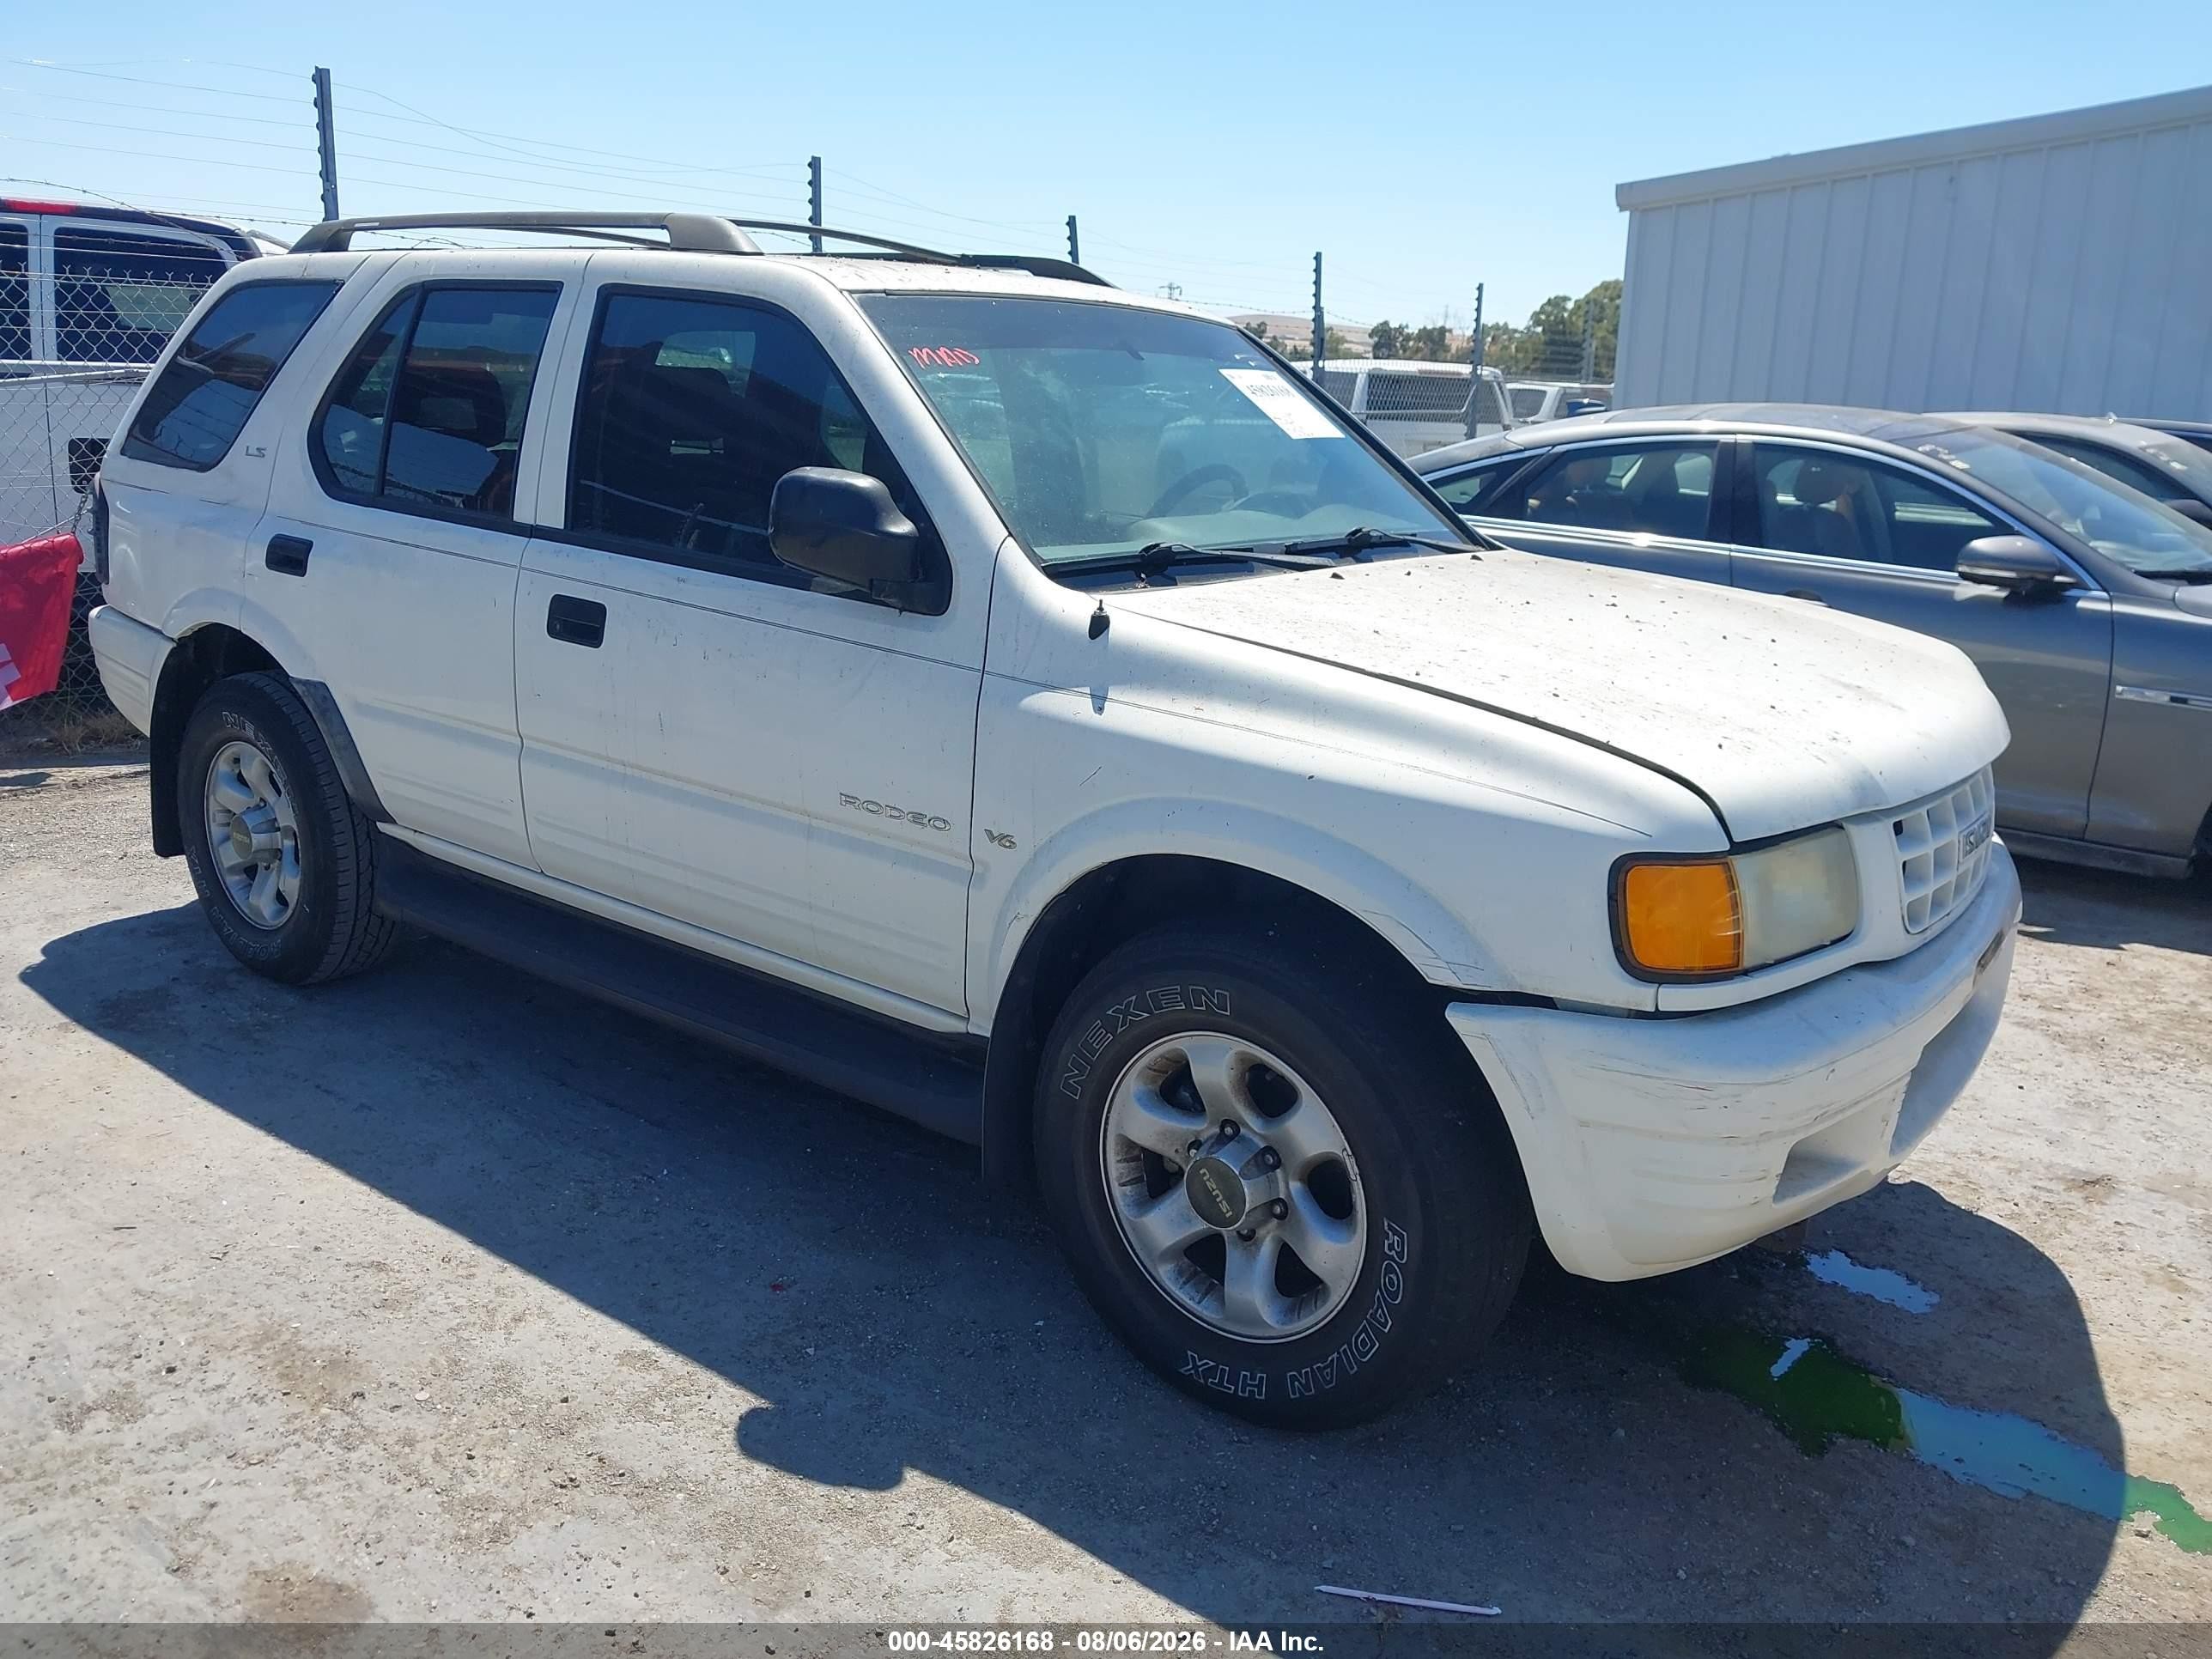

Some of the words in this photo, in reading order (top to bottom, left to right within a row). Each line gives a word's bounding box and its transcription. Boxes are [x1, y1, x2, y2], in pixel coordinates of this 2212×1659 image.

[245, 445, 268, 458] LS
[839, 793, 951, 831] RODEO
[984, 829, 1018, 849] V6
[1060, 985, 1231, 1100] NEXEN
[1199, 1168, 1233, 1218] ISUZU
[1287, 1217, 1408, 1399] ROADIAN
[1180, 1350, 1267, 1400] HTX
